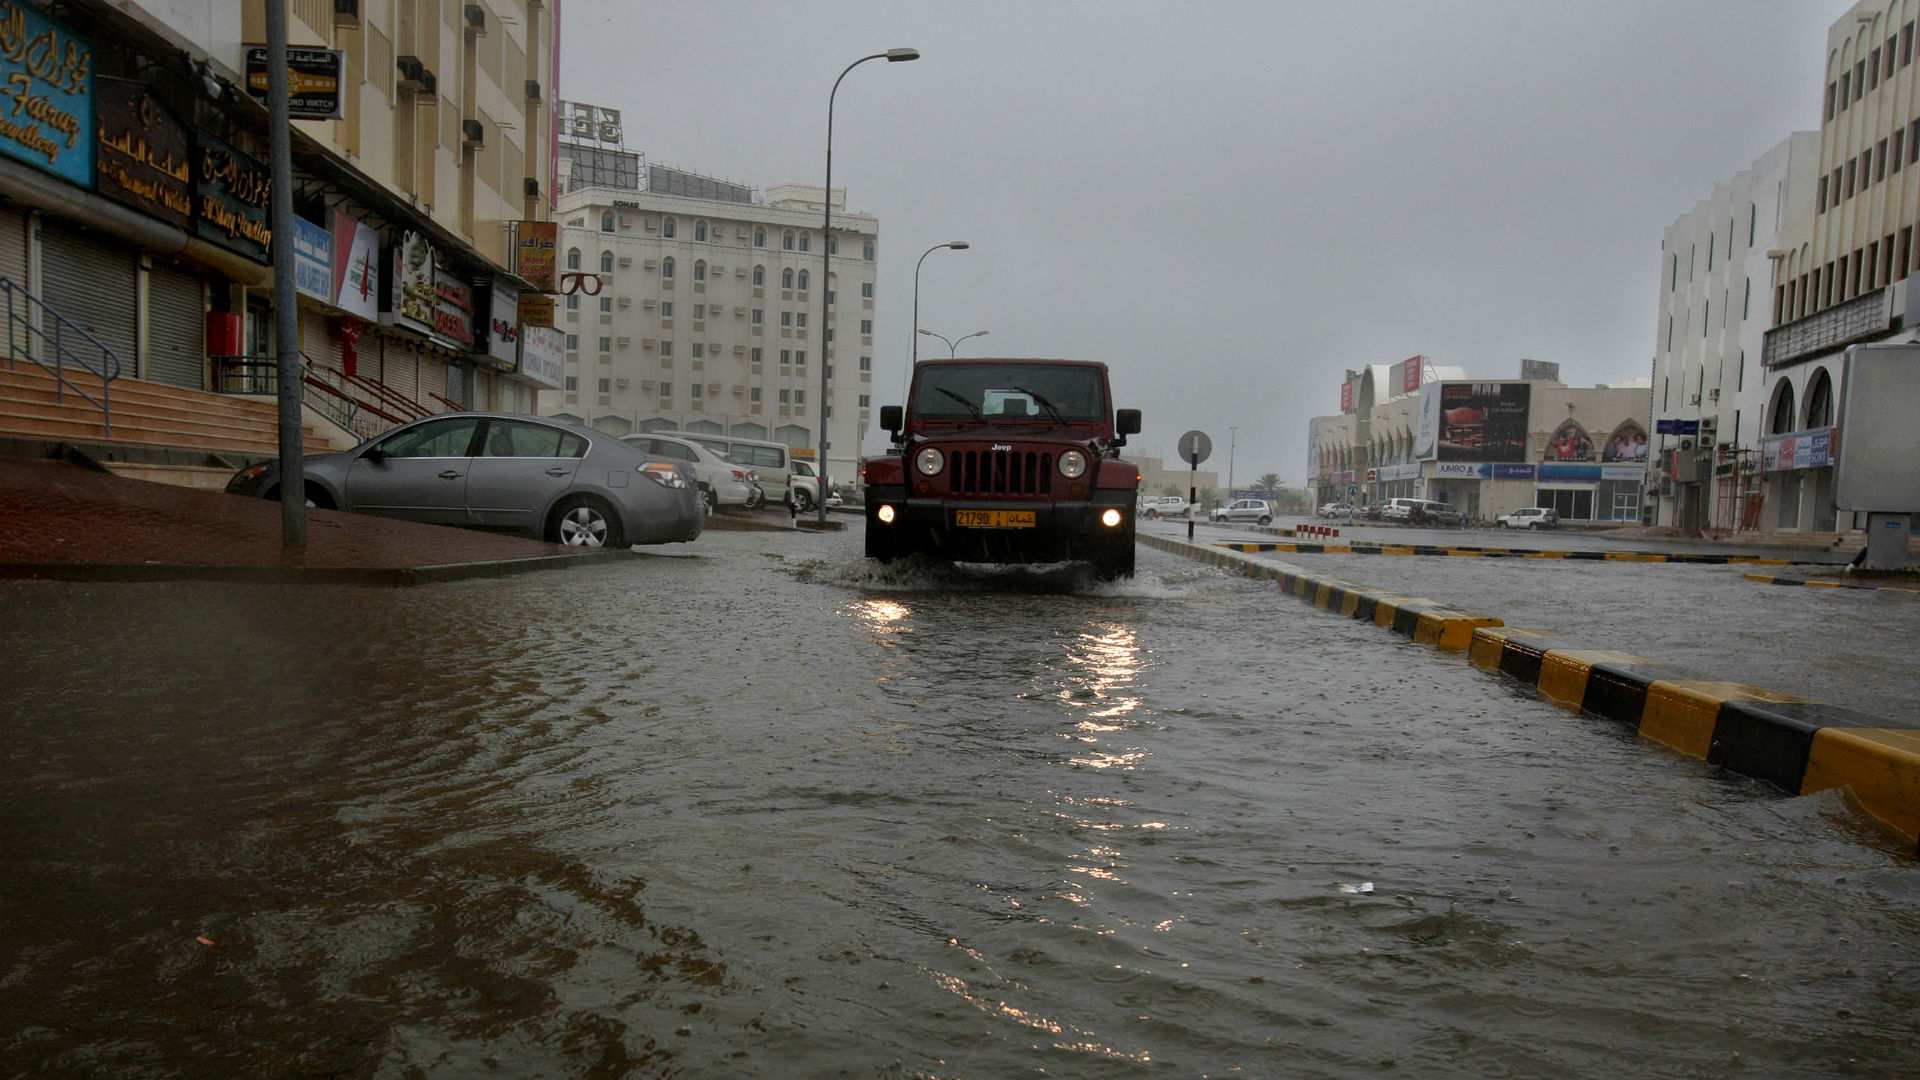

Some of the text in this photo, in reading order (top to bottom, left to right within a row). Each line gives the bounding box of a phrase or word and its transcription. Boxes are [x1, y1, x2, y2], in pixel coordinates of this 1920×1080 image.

[613, 200, 640, 209] SOHAR
[992, 443, 1012, 451] Jeep
[1440, 464, 1466, 473] JUMBO
